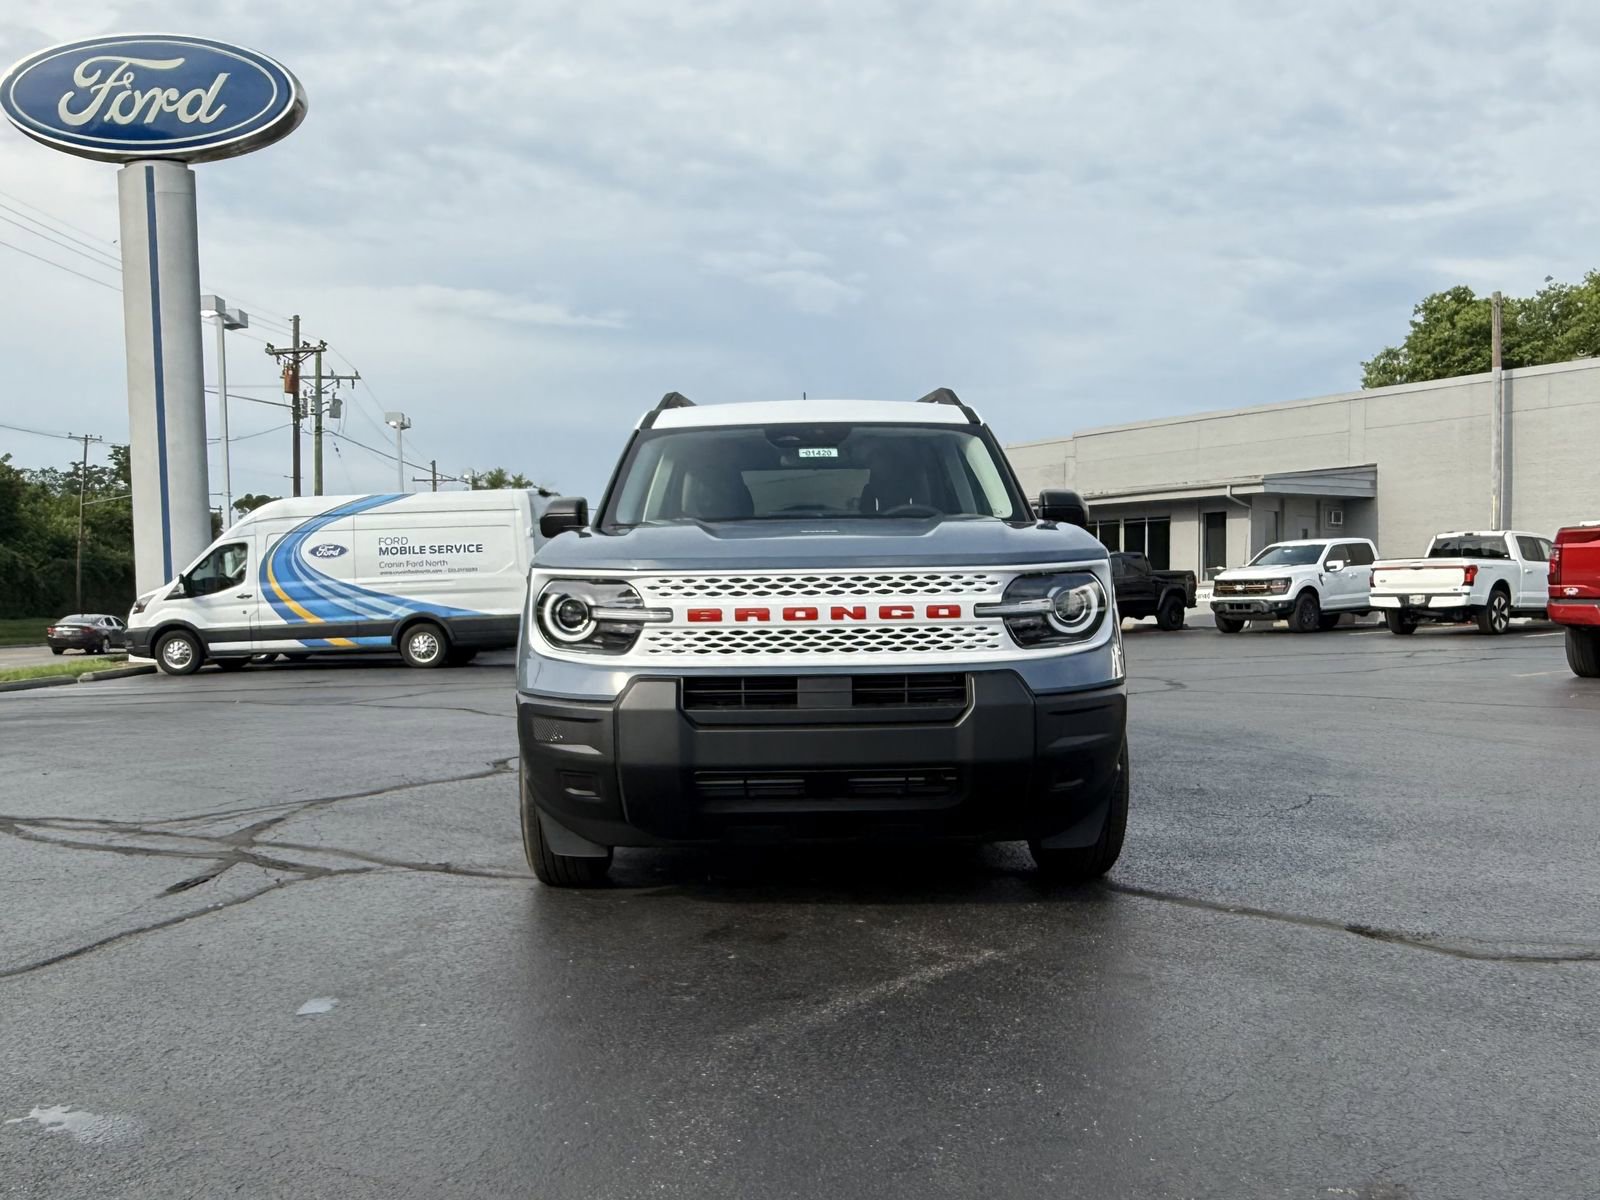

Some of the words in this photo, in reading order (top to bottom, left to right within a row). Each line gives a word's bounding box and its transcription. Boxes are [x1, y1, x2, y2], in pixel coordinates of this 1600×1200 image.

[58, 55, 231, 125] Ford
[378, 536, 409, 546] FORD
[316, 544, 341, 557] Ford
[378, 545, 427, 556] MOBILE
[429, 543, 484, 554] SERVICE
[379, 560, 405, 569] Cronin
[406, 559, 424, 568] Ford
[425, 559, 449, 567] North
[687, 605, 961, 622] BRONCO
